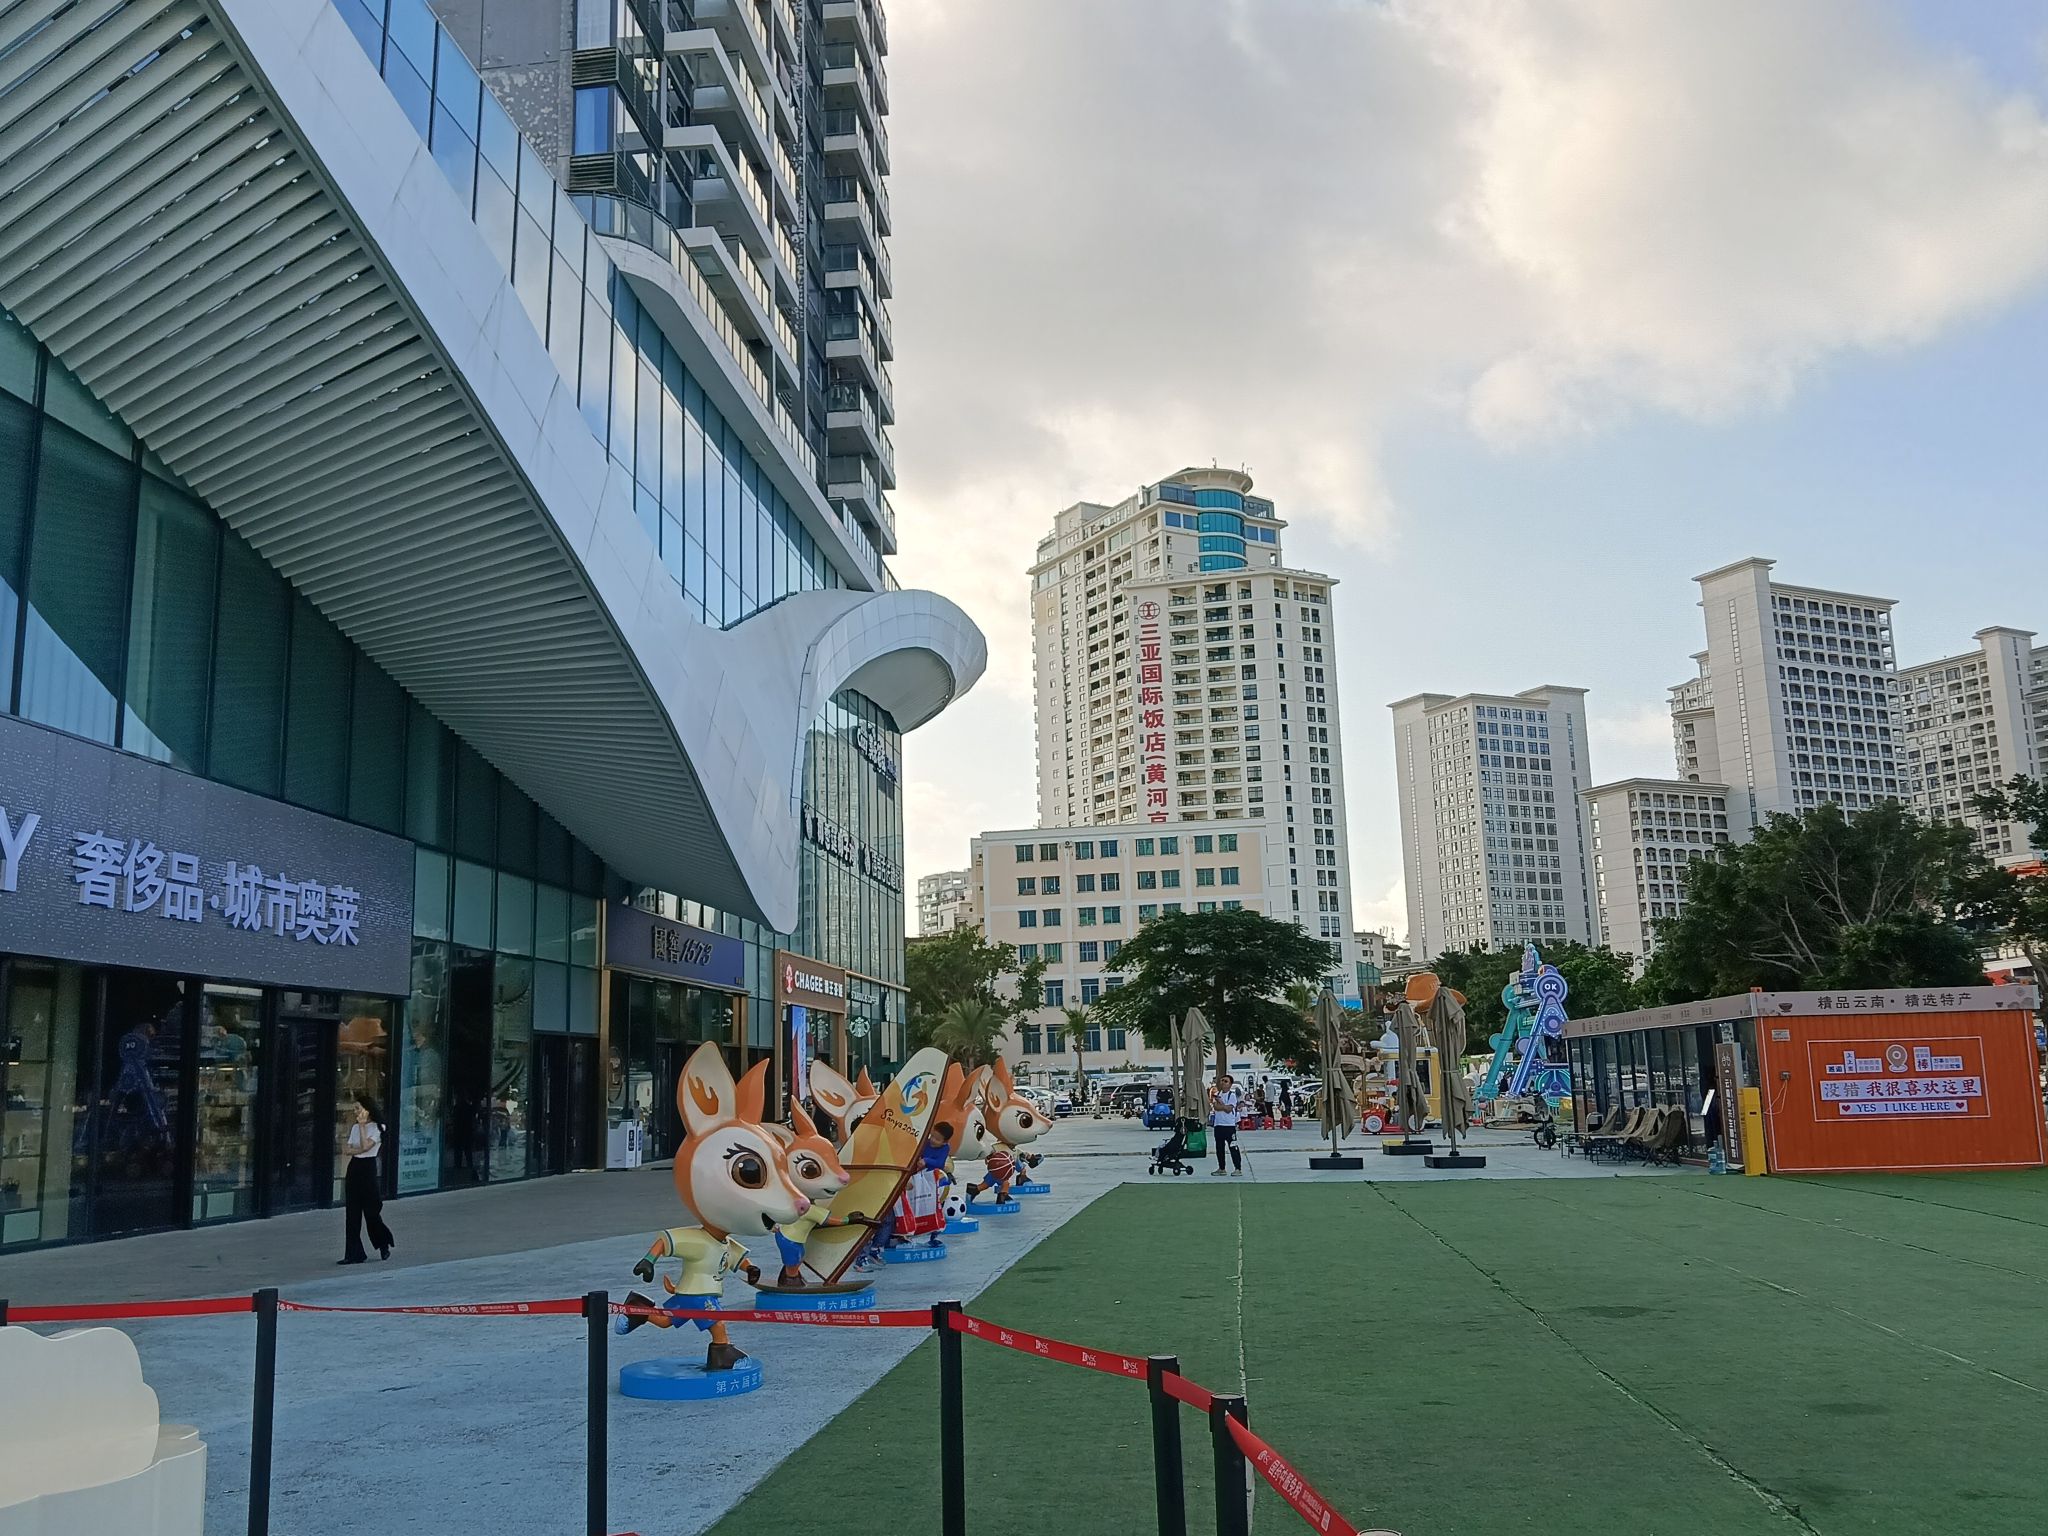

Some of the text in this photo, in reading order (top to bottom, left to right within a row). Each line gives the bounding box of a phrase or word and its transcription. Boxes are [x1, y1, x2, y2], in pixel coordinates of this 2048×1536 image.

[794, 970, 823, 993] CHAGEE
[1544, 983, 1557, 991] OK
[1824, 1079, 1978, 1098] 没错 我很喜欢这里
[1856, 1101, 1951, 1113] YES I LIKE HERE
[716, 1372, 762, 1394] 第六届亚
